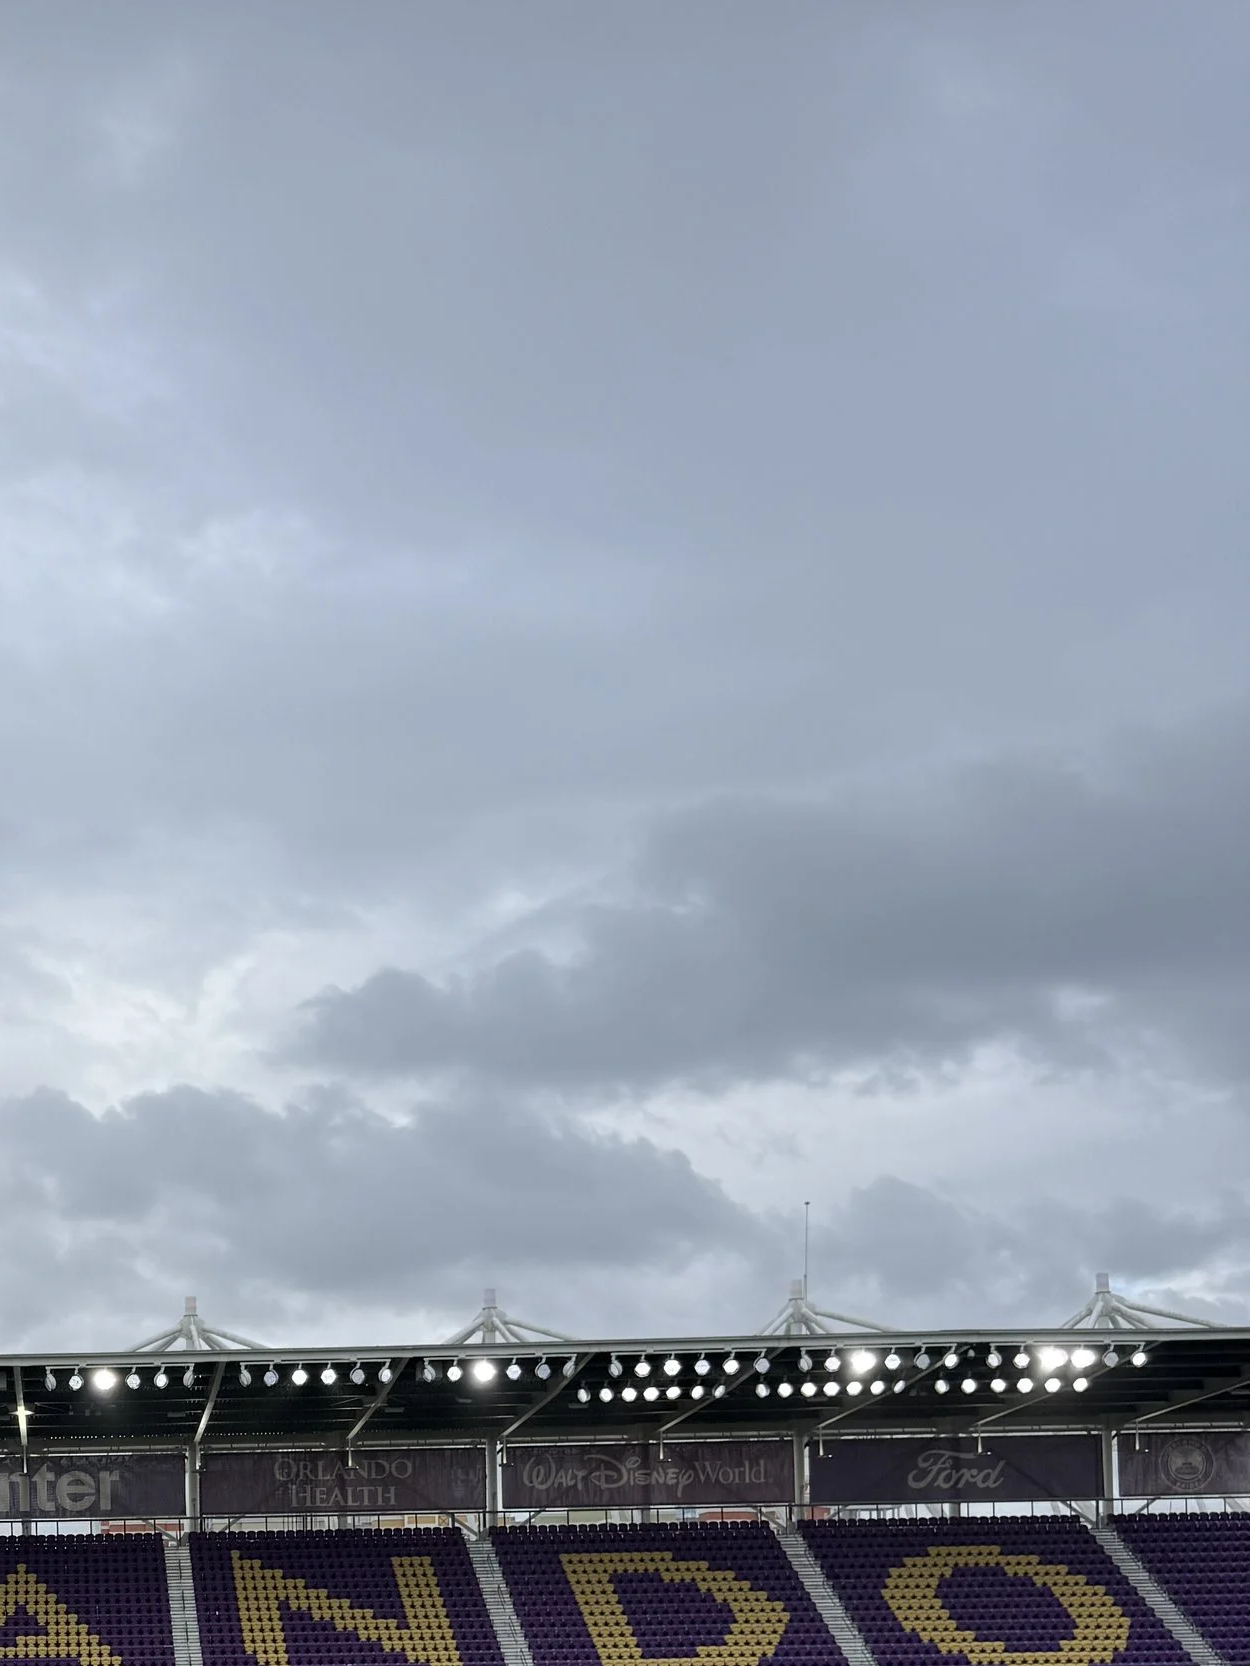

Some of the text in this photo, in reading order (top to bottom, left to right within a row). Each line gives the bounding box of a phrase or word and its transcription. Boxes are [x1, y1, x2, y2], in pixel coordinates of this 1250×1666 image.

[274, 1457, 412, 1482] ORLANDO
[695, 1460, 766, 1484] World
[907, 1449, 1005, 1489] Ford
[289, 1483, 396, 1508] HEALTH
